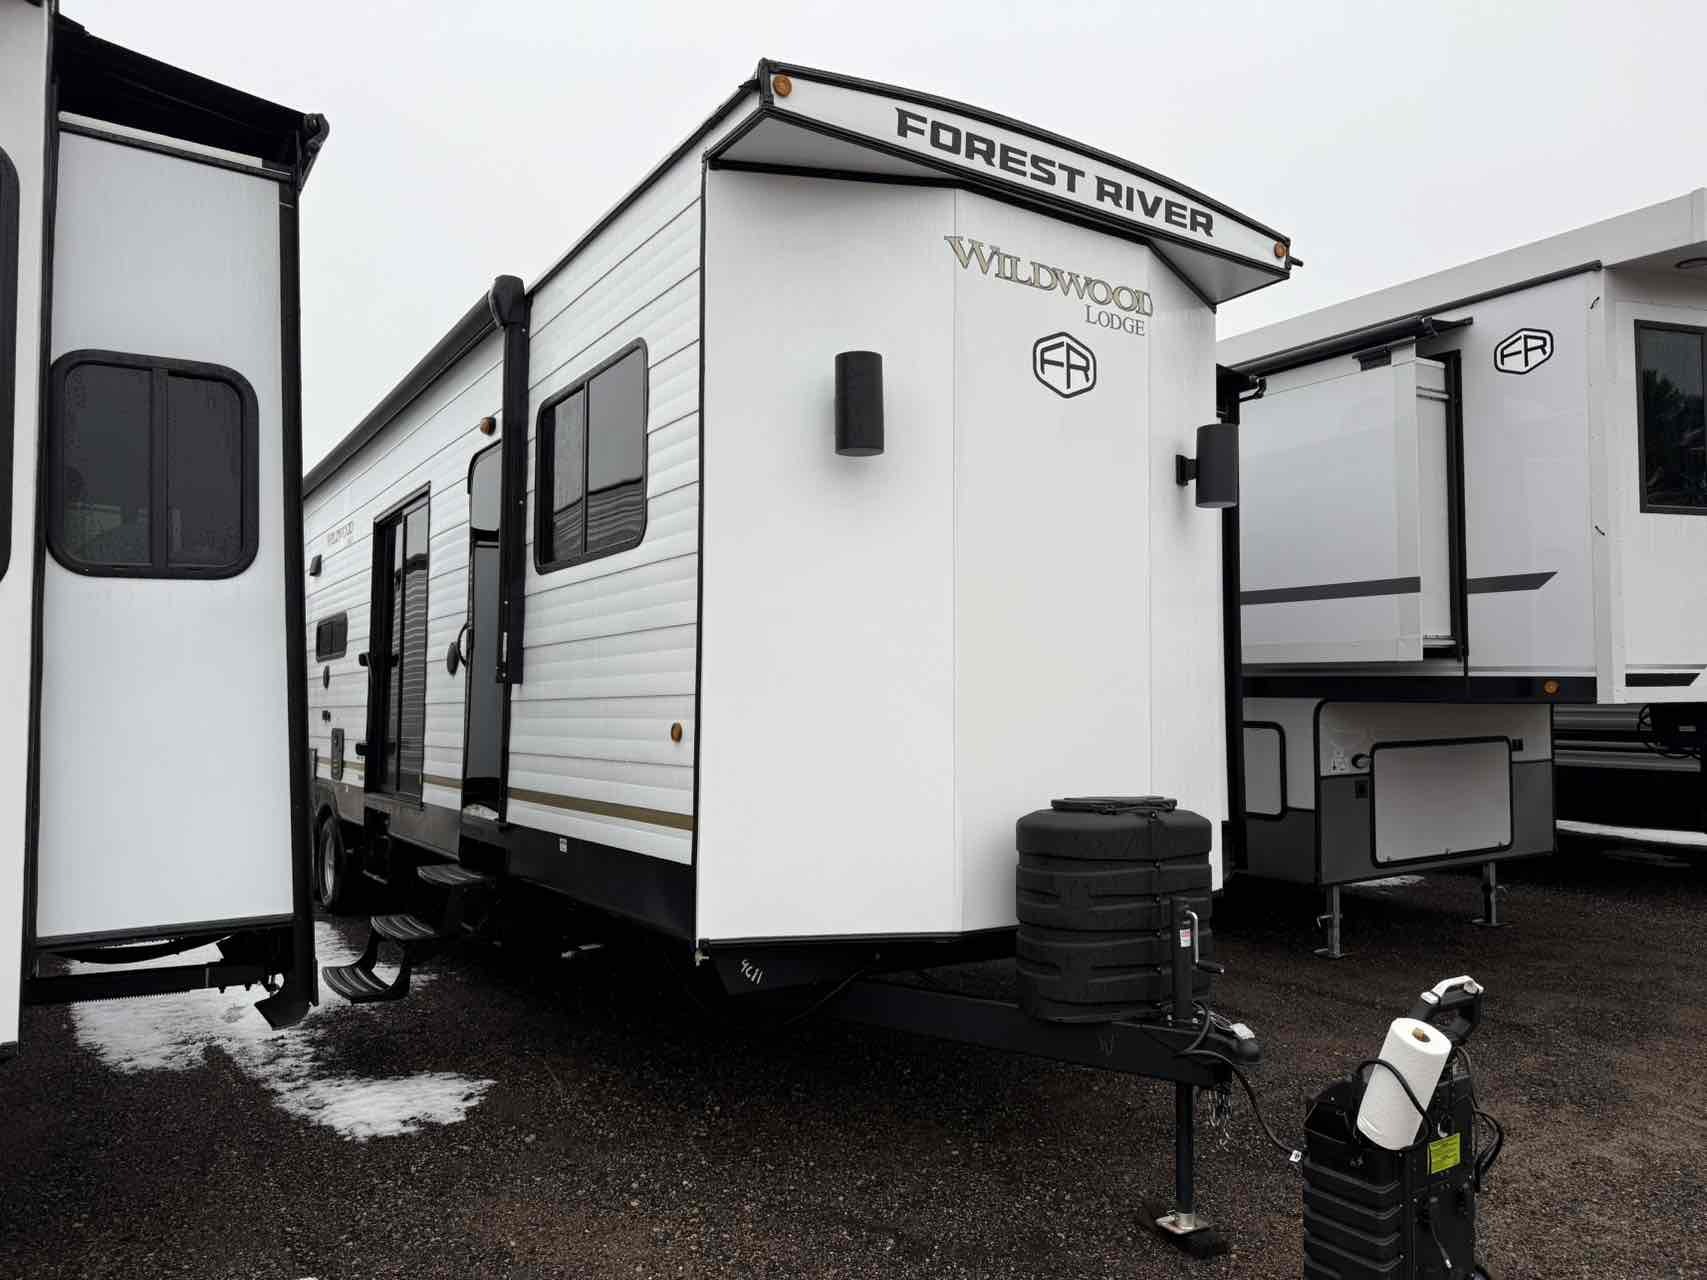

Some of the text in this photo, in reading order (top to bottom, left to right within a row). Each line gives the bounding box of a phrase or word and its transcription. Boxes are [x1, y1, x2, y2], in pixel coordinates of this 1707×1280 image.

[894, 106, 1214, 238] FOREST RIVER
[943, 235, 1154, 318] WILDWOOD
[1083, 303, 1146, 337] LODGE
[1038, 338, 1092, 391] FR
[1499, 332, 1549, 370] FR
